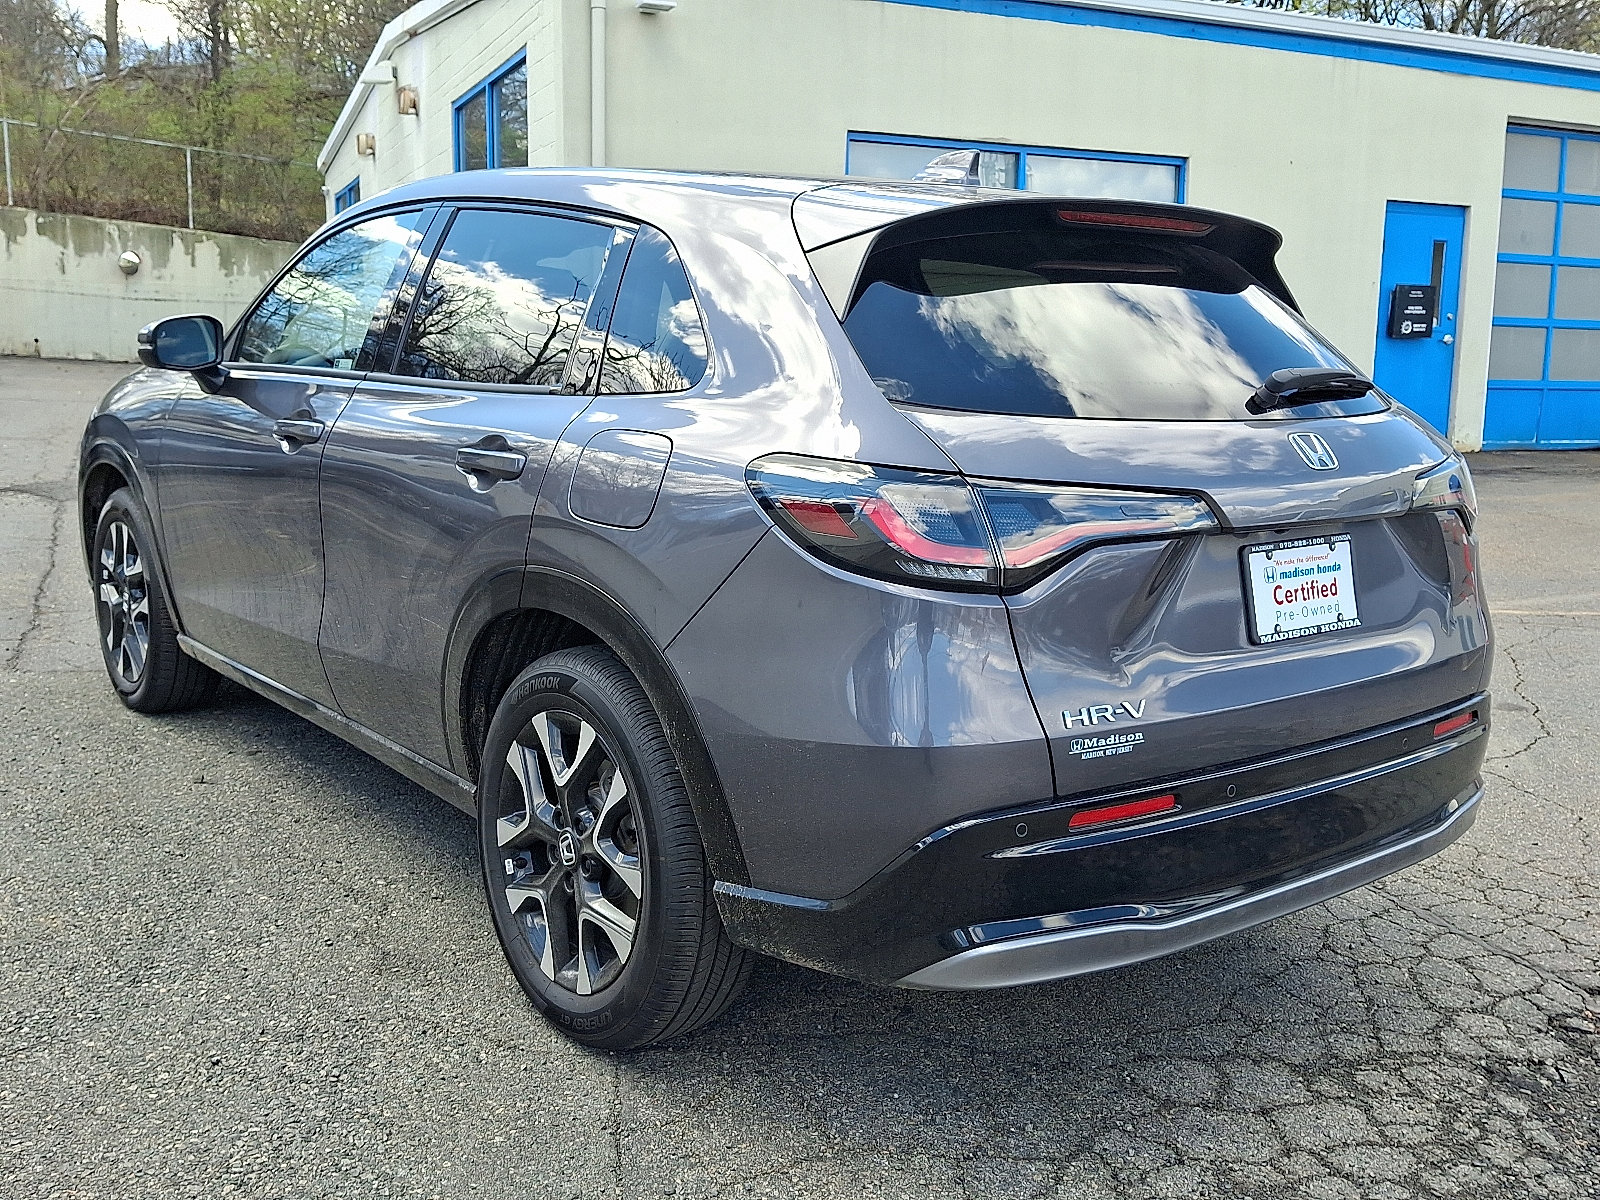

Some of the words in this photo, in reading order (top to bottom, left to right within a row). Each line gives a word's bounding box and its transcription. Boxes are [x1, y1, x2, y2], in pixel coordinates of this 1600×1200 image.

[1330, 534, 1352, 542] HONDA
[1279, 566, 1315, 580] madison
[1316, 561, 1341, 575] honda
[1273, 577, 1338, 606] Certified
[1276, 600, 1341, 622] Pre-Owned
[1260, 625, 1318, 644] MADISON
[1320, 618, 1362, 634] HONDA
[1061, 698, 1147, 730] HR-V
[1083, 732, 1144, 749] Madison
